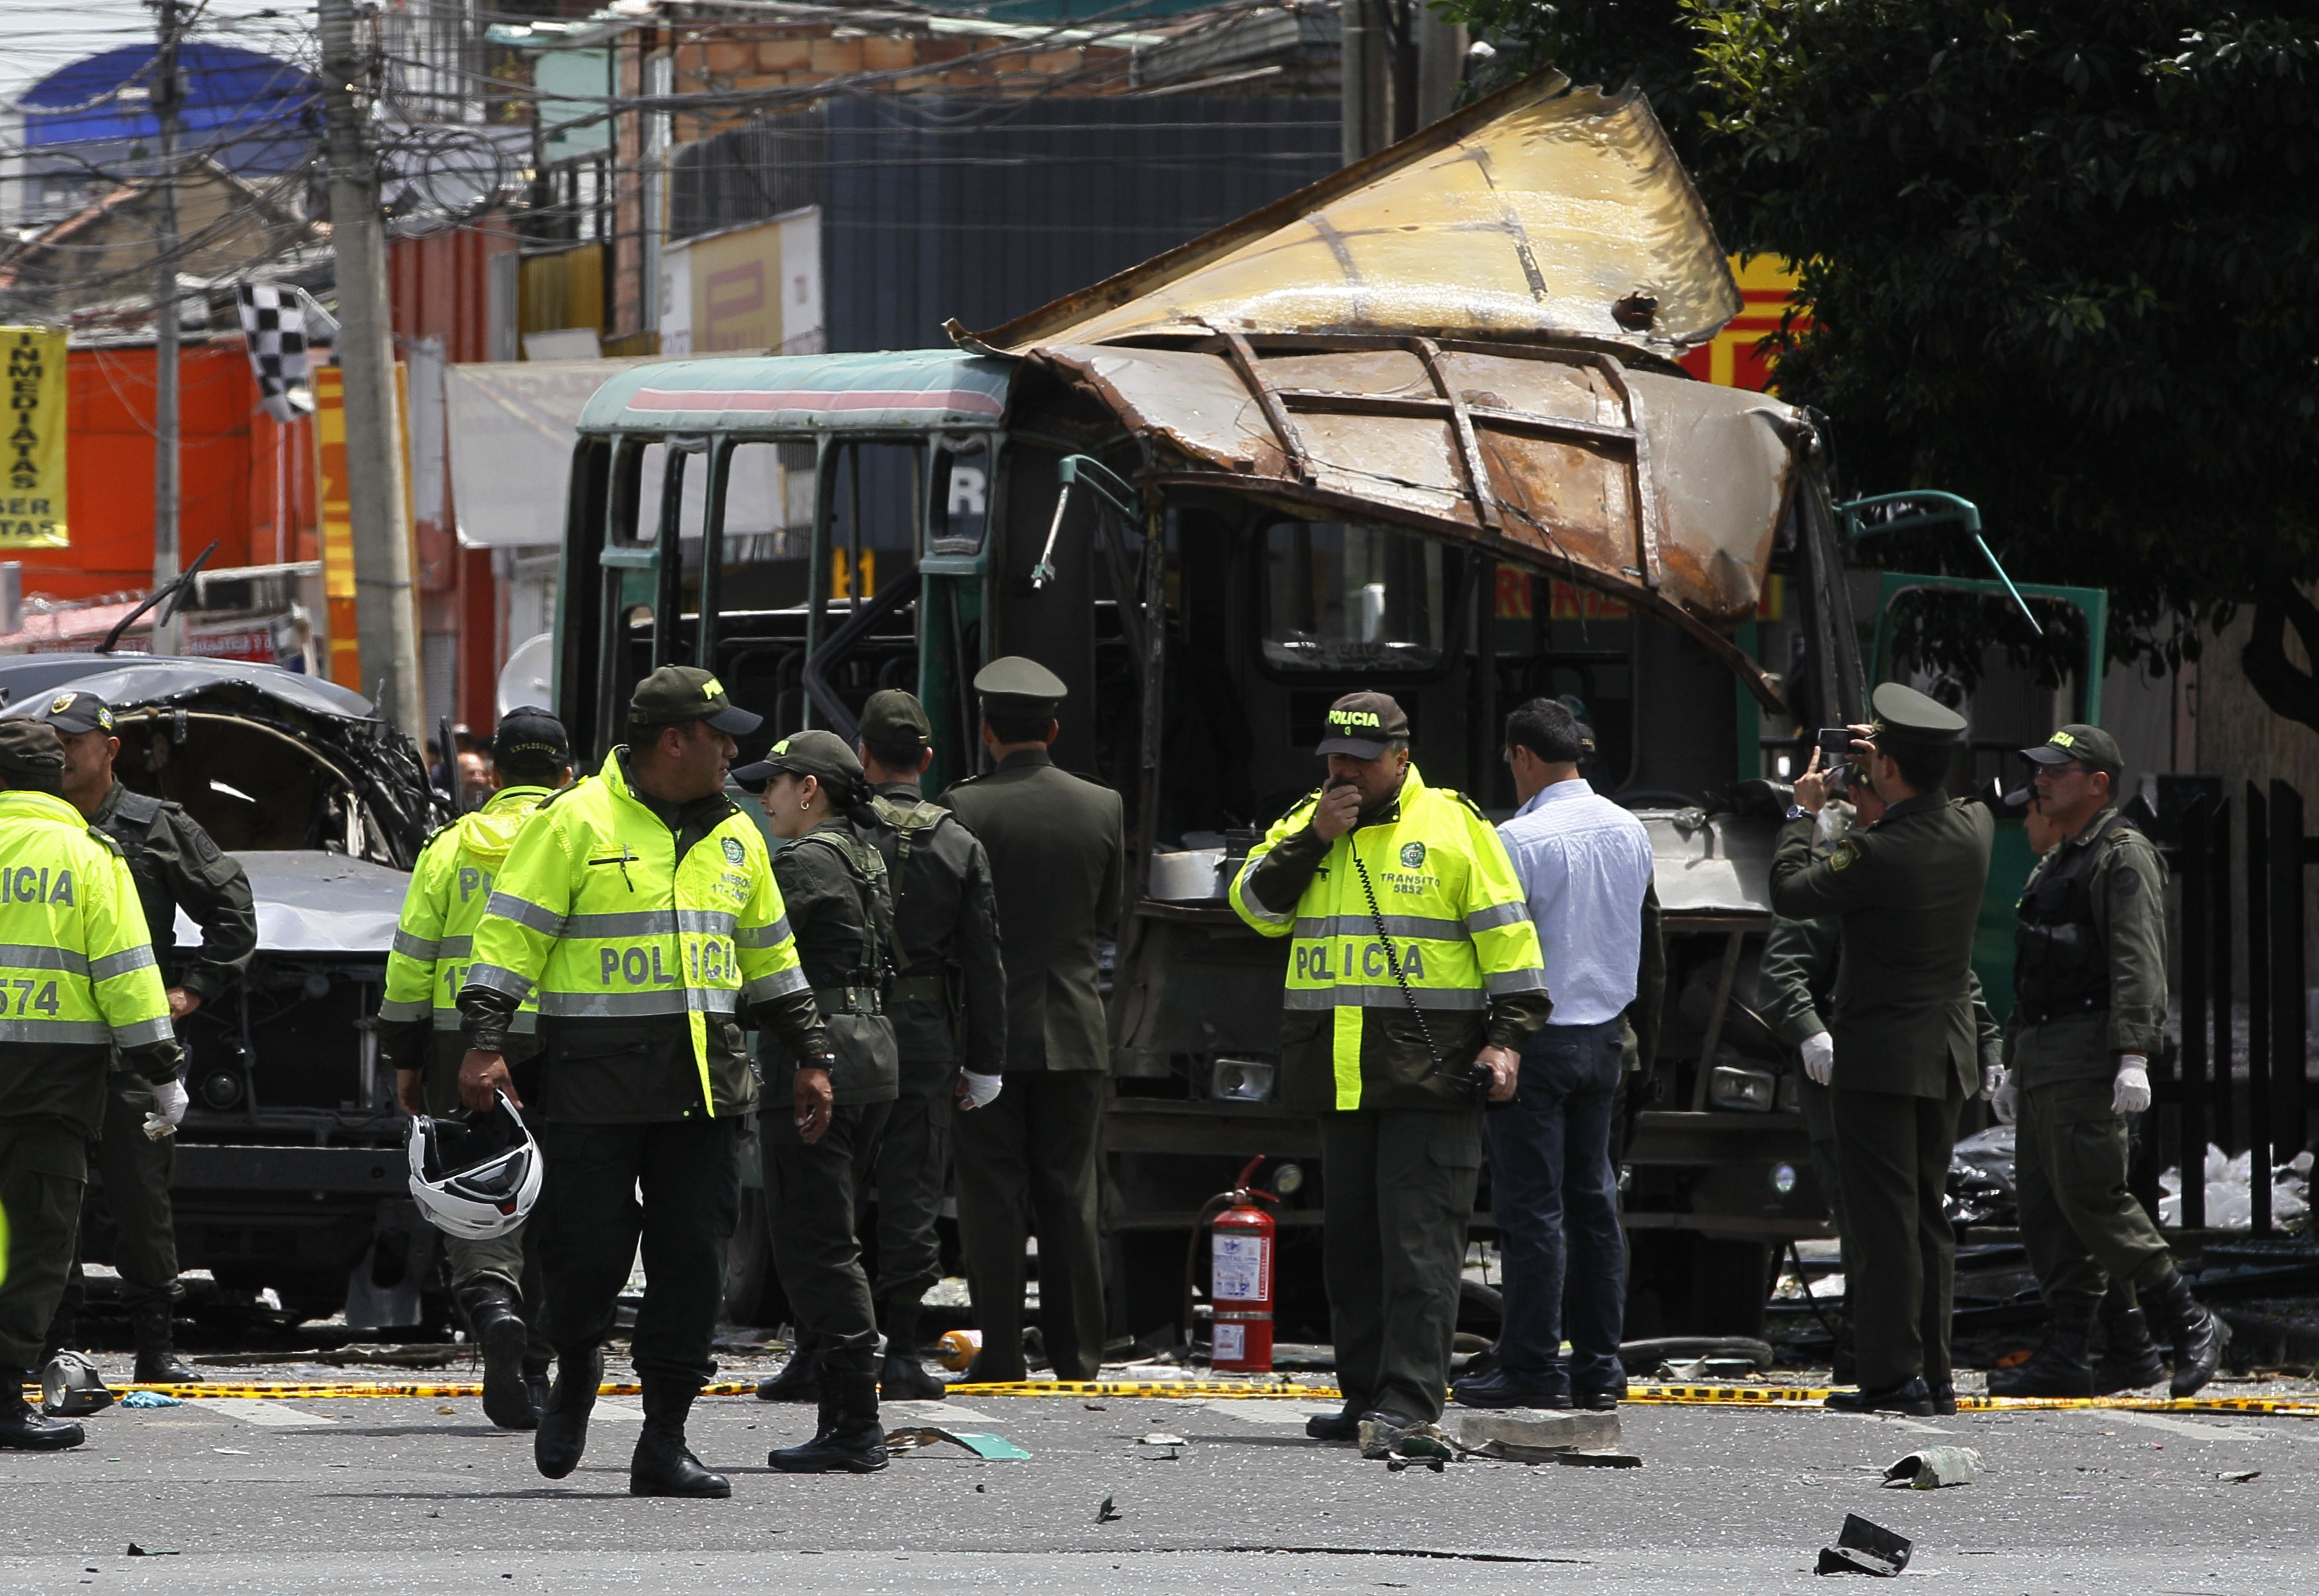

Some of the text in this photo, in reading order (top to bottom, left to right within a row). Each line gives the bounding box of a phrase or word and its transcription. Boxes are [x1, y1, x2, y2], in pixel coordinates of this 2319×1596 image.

[9, 333, 42, 489] INMEDIATAS
[1329, 710, 1381, 727] POLICIA
[1381, 873, 1441, 888] TRANSITO
[1297, 942, 1425, 981] POLICIA
